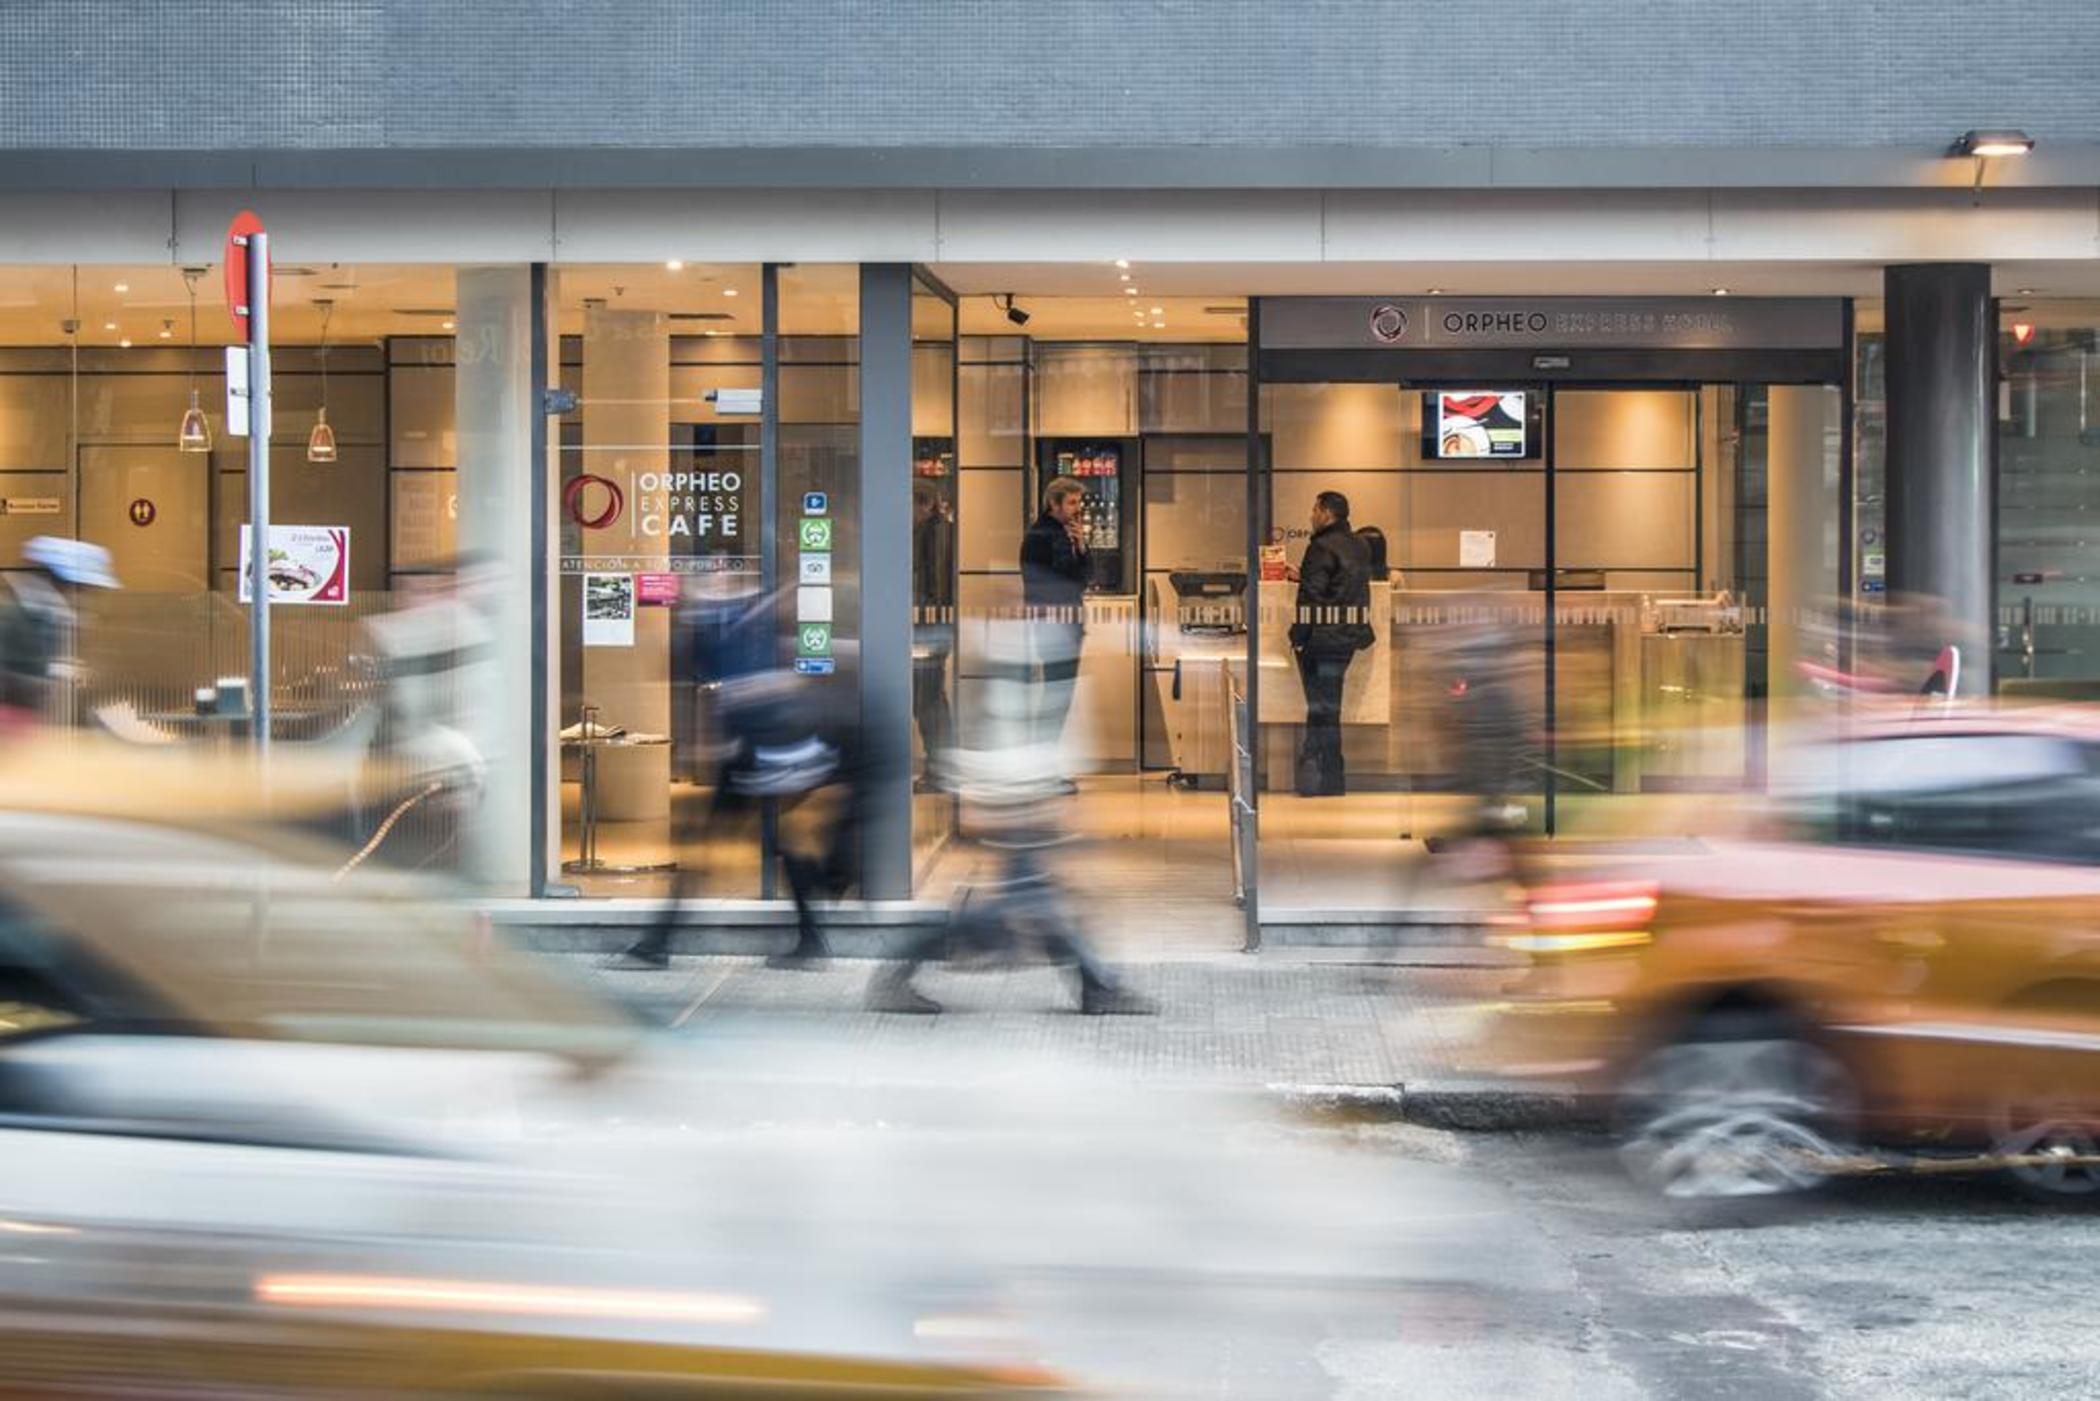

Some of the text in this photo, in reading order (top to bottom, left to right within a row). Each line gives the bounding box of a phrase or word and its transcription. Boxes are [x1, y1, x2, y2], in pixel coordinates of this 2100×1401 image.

[1443, 312, 1547, 332] ORPHEO
[639, 472, 741, 492] ORPHEO
[641, 497, 740, 512] EXPRESS
[641, 514, 738, 537] CAFE
